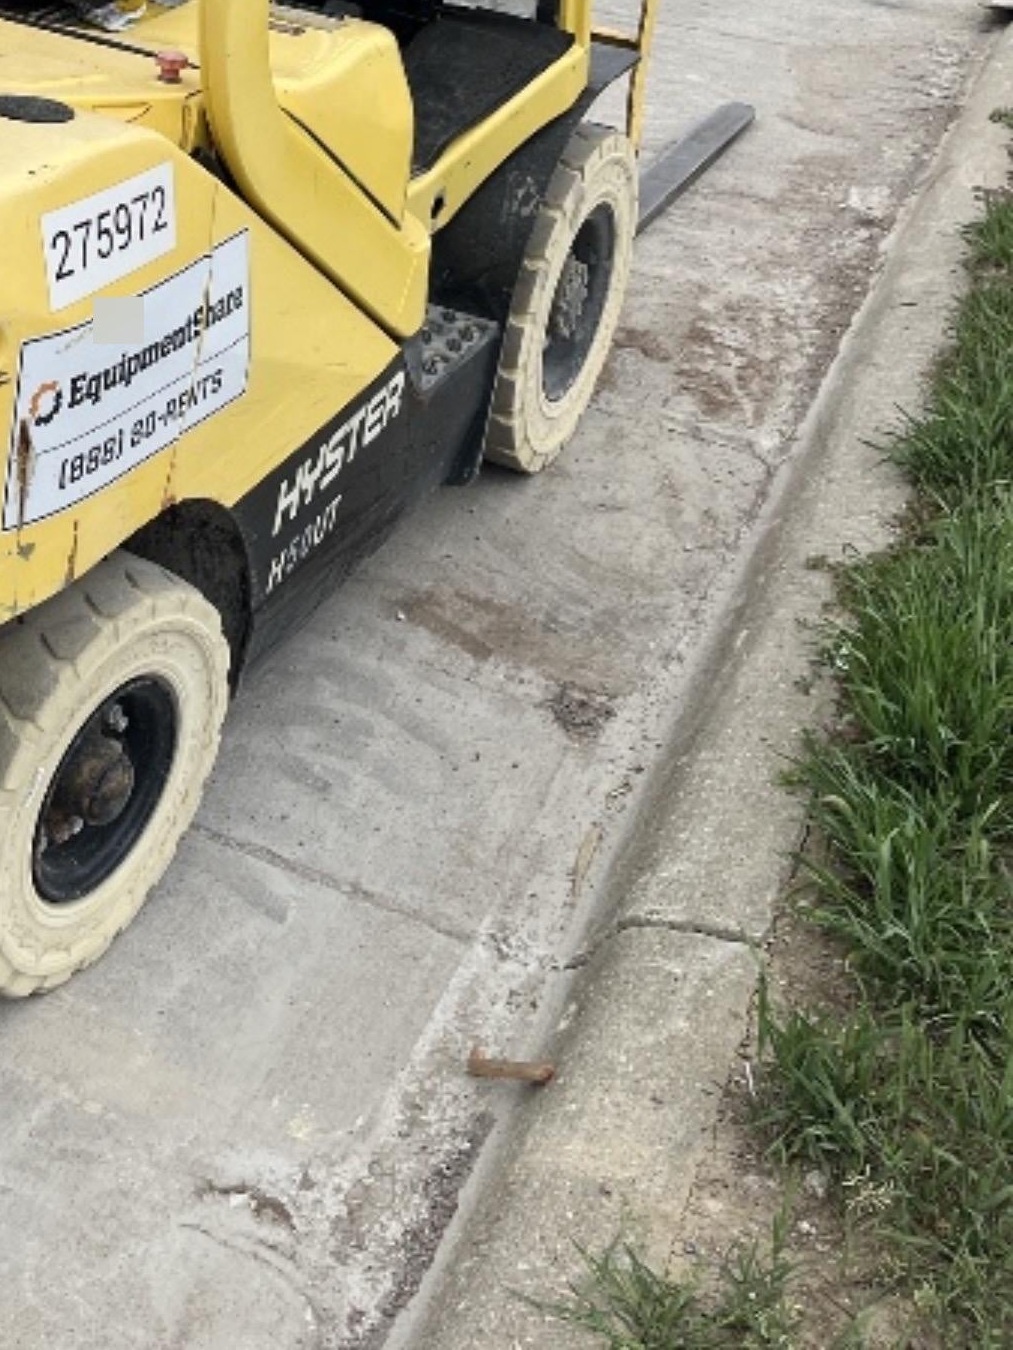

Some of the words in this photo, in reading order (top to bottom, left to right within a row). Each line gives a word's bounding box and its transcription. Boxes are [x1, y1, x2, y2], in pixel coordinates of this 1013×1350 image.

[50, 185, 169, 283] 275972
[67, 285, 244, 410] EquipmentShare
[58, 428, 125, 491] (888)
[130, 368, 224, 449] 80-RENTS
[272, 371, 406, 538] HYSTER
